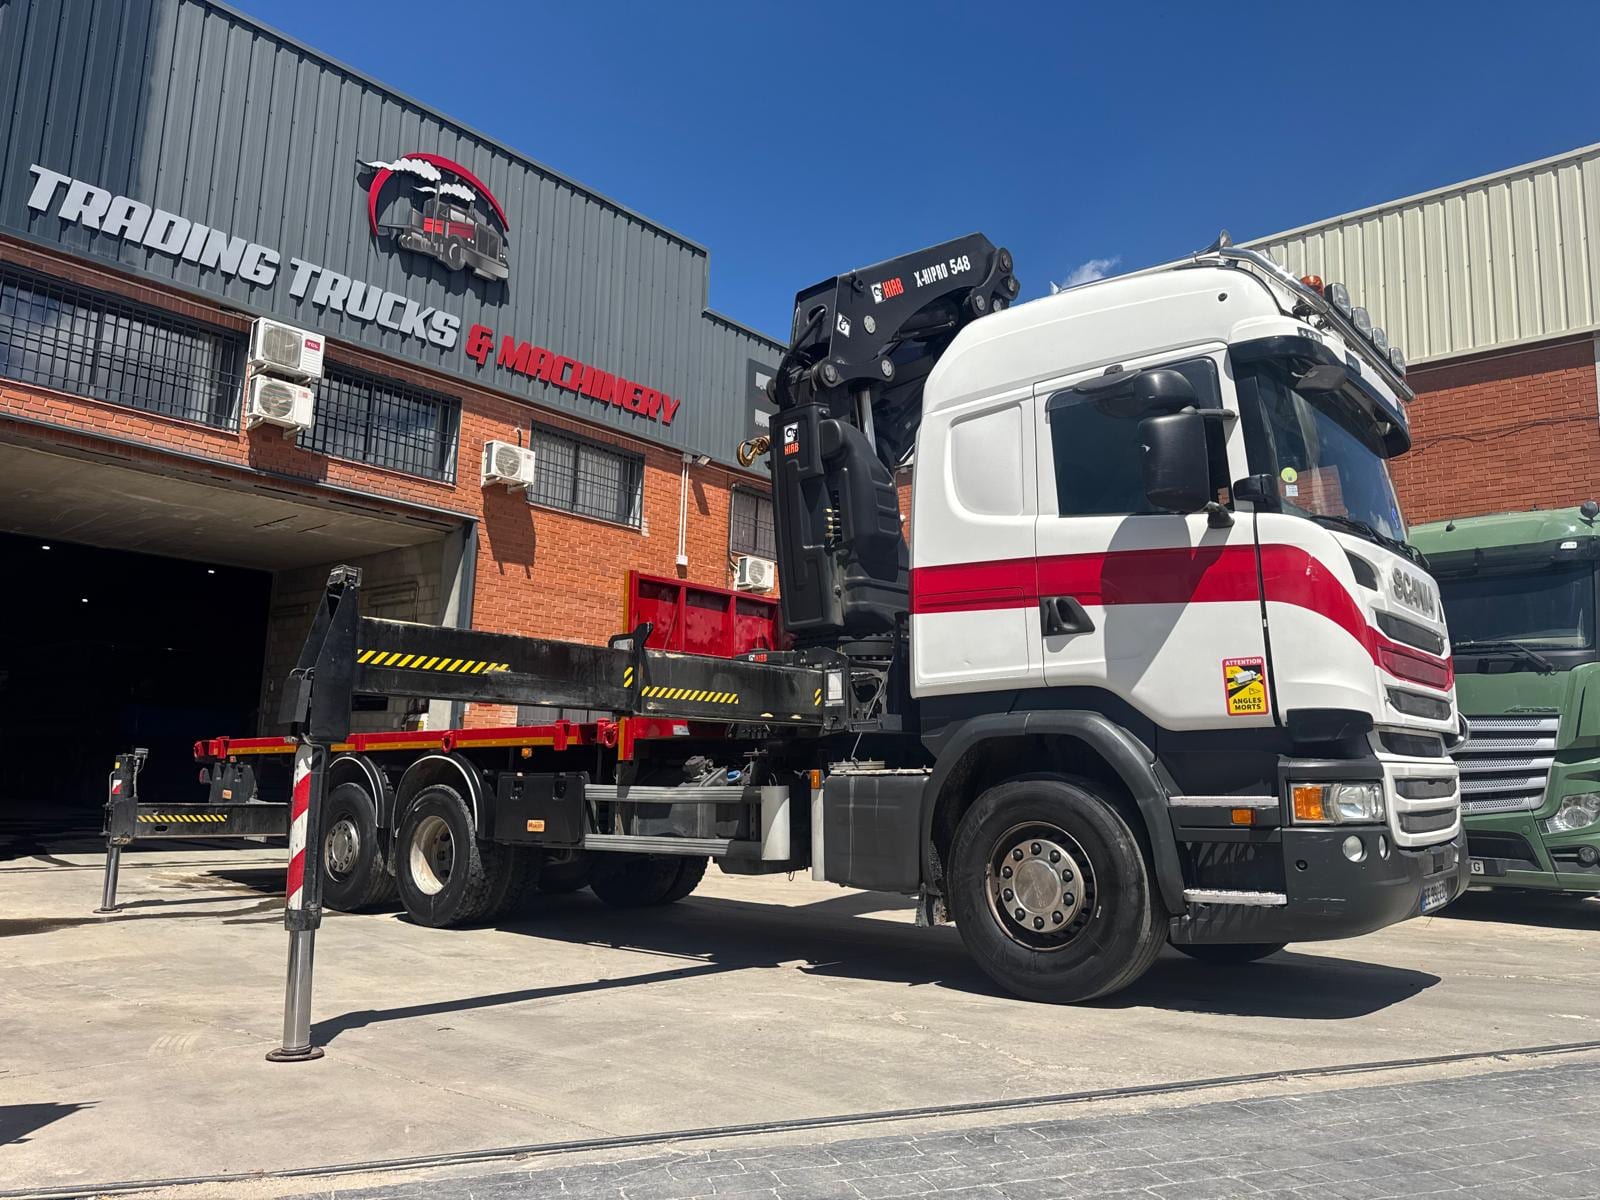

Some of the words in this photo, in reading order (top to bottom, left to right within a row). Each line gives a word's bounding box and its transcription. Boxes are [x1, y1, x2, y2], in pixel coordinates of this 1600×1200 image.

[913, 262, 949, 288] X-HIPRO
[949, 254, 971, 275] 548
[27, 163, 281, 286] TRADING
[289, 256, 461, 348] TRUCKS
[465, 323, 494, 365] &
[497, 335, 681, 424] MACHINERY
[882, 277, 905, 299] HIAB
[784, 442, 799, 456] HIAB
[1392, 567, 1434, 615] SCANIA
[1232, 697, 1262, 705] ANGLES
